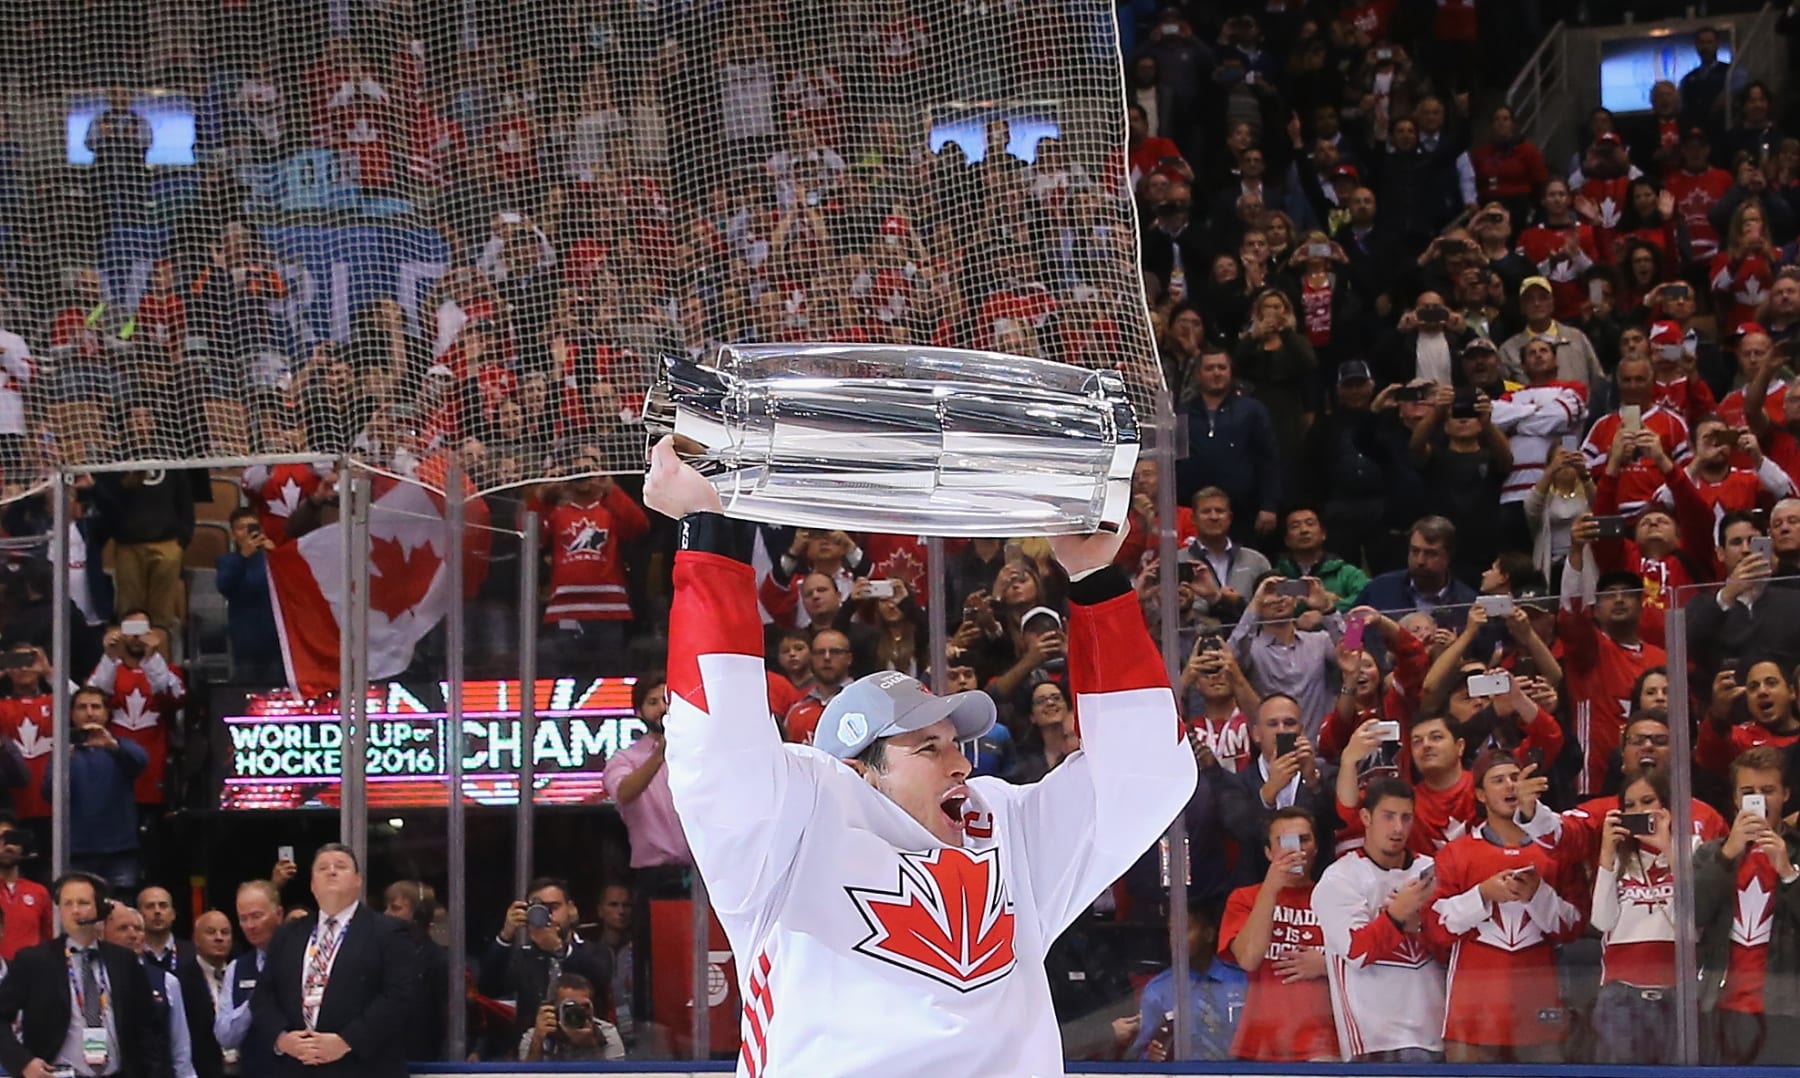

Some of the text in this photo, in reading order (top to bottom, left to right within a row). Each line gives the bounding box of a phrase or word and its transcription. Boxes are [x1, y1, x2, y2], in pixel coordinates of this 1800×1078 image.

[229, 724, 343, 749] WORLD
[362, 722, 412, 747] UP
[235, 747, 435, 775] HOCKE 2016
[964, 811, 993, 838] C
[1273, 905, 1320, 926] ANAD
[1285, 927, 1300, 943] IS
